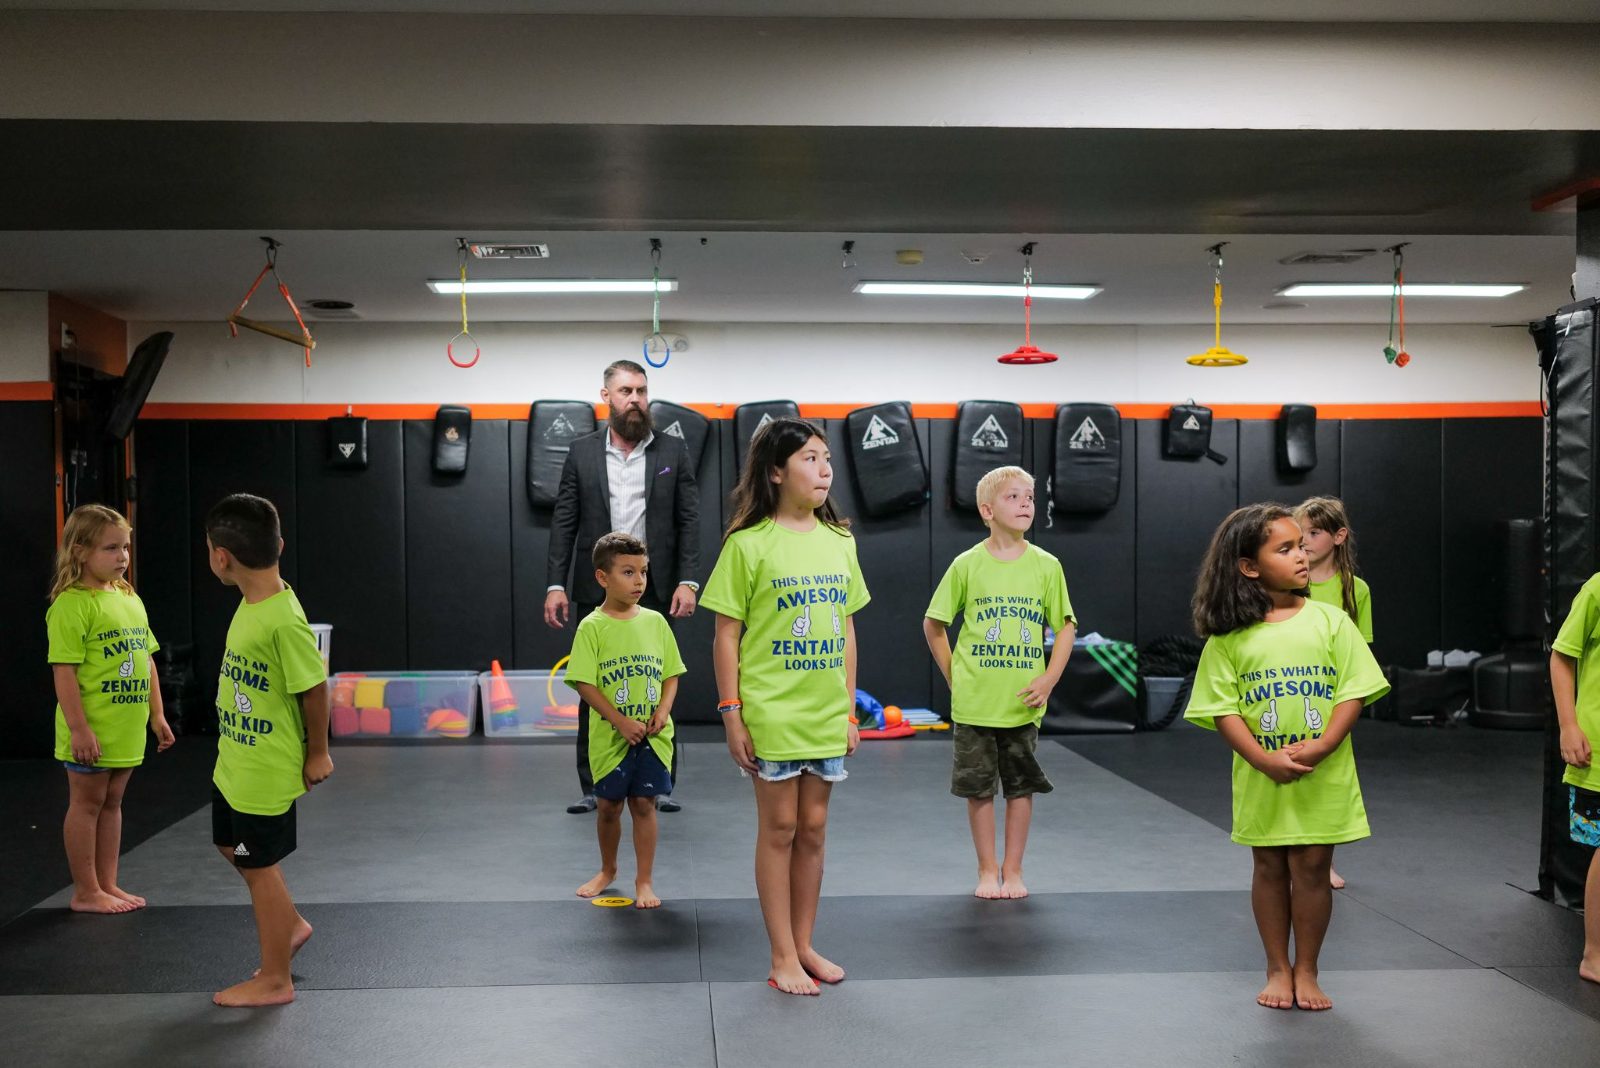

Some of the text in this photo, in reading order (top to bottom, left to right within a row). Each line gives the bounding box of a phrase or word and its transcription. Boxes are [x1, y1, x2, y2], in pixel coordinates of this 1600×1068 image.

[771, 577, 798, 589] THIS
[801, 576, 811, 586] IS
[813, 575, 844, 585] WHAT
[974, 597, 993, 606] THIS
[995, 596, 1004, 604] IS
[1007, 596, 1034, 606] WHAT
[97, 629, 120, 641] THIS
[122, 628, 130, 636] IS
[772, 638, 834, 656] ZENTAI
[971, 644, 1042, 659] ZENTAI KID
[252, 661, 268, 673] AN
[599, 659, 617, 671] THIS
[620, 655, 629, 664] IS
[785, 658, 827, 671] LOOKS
[979, 659, 1034, 670] LOOKS LIKE
[221, 662, 270, 693] SOME
[1240, 665, 1337, 683] THIS IS WHAT AN
[101, 678, 149, 694] ZENTAI
[1245, 680, 1335, 706] AWESOME
[111, 694, 143, 705] LOOKS
[617, 703, 647, 716] NTAI
[241, 715, 273, 735] KID
[232, 731, 256, 746] LIKE
[1253, 733, 1306, 751] ENTA
